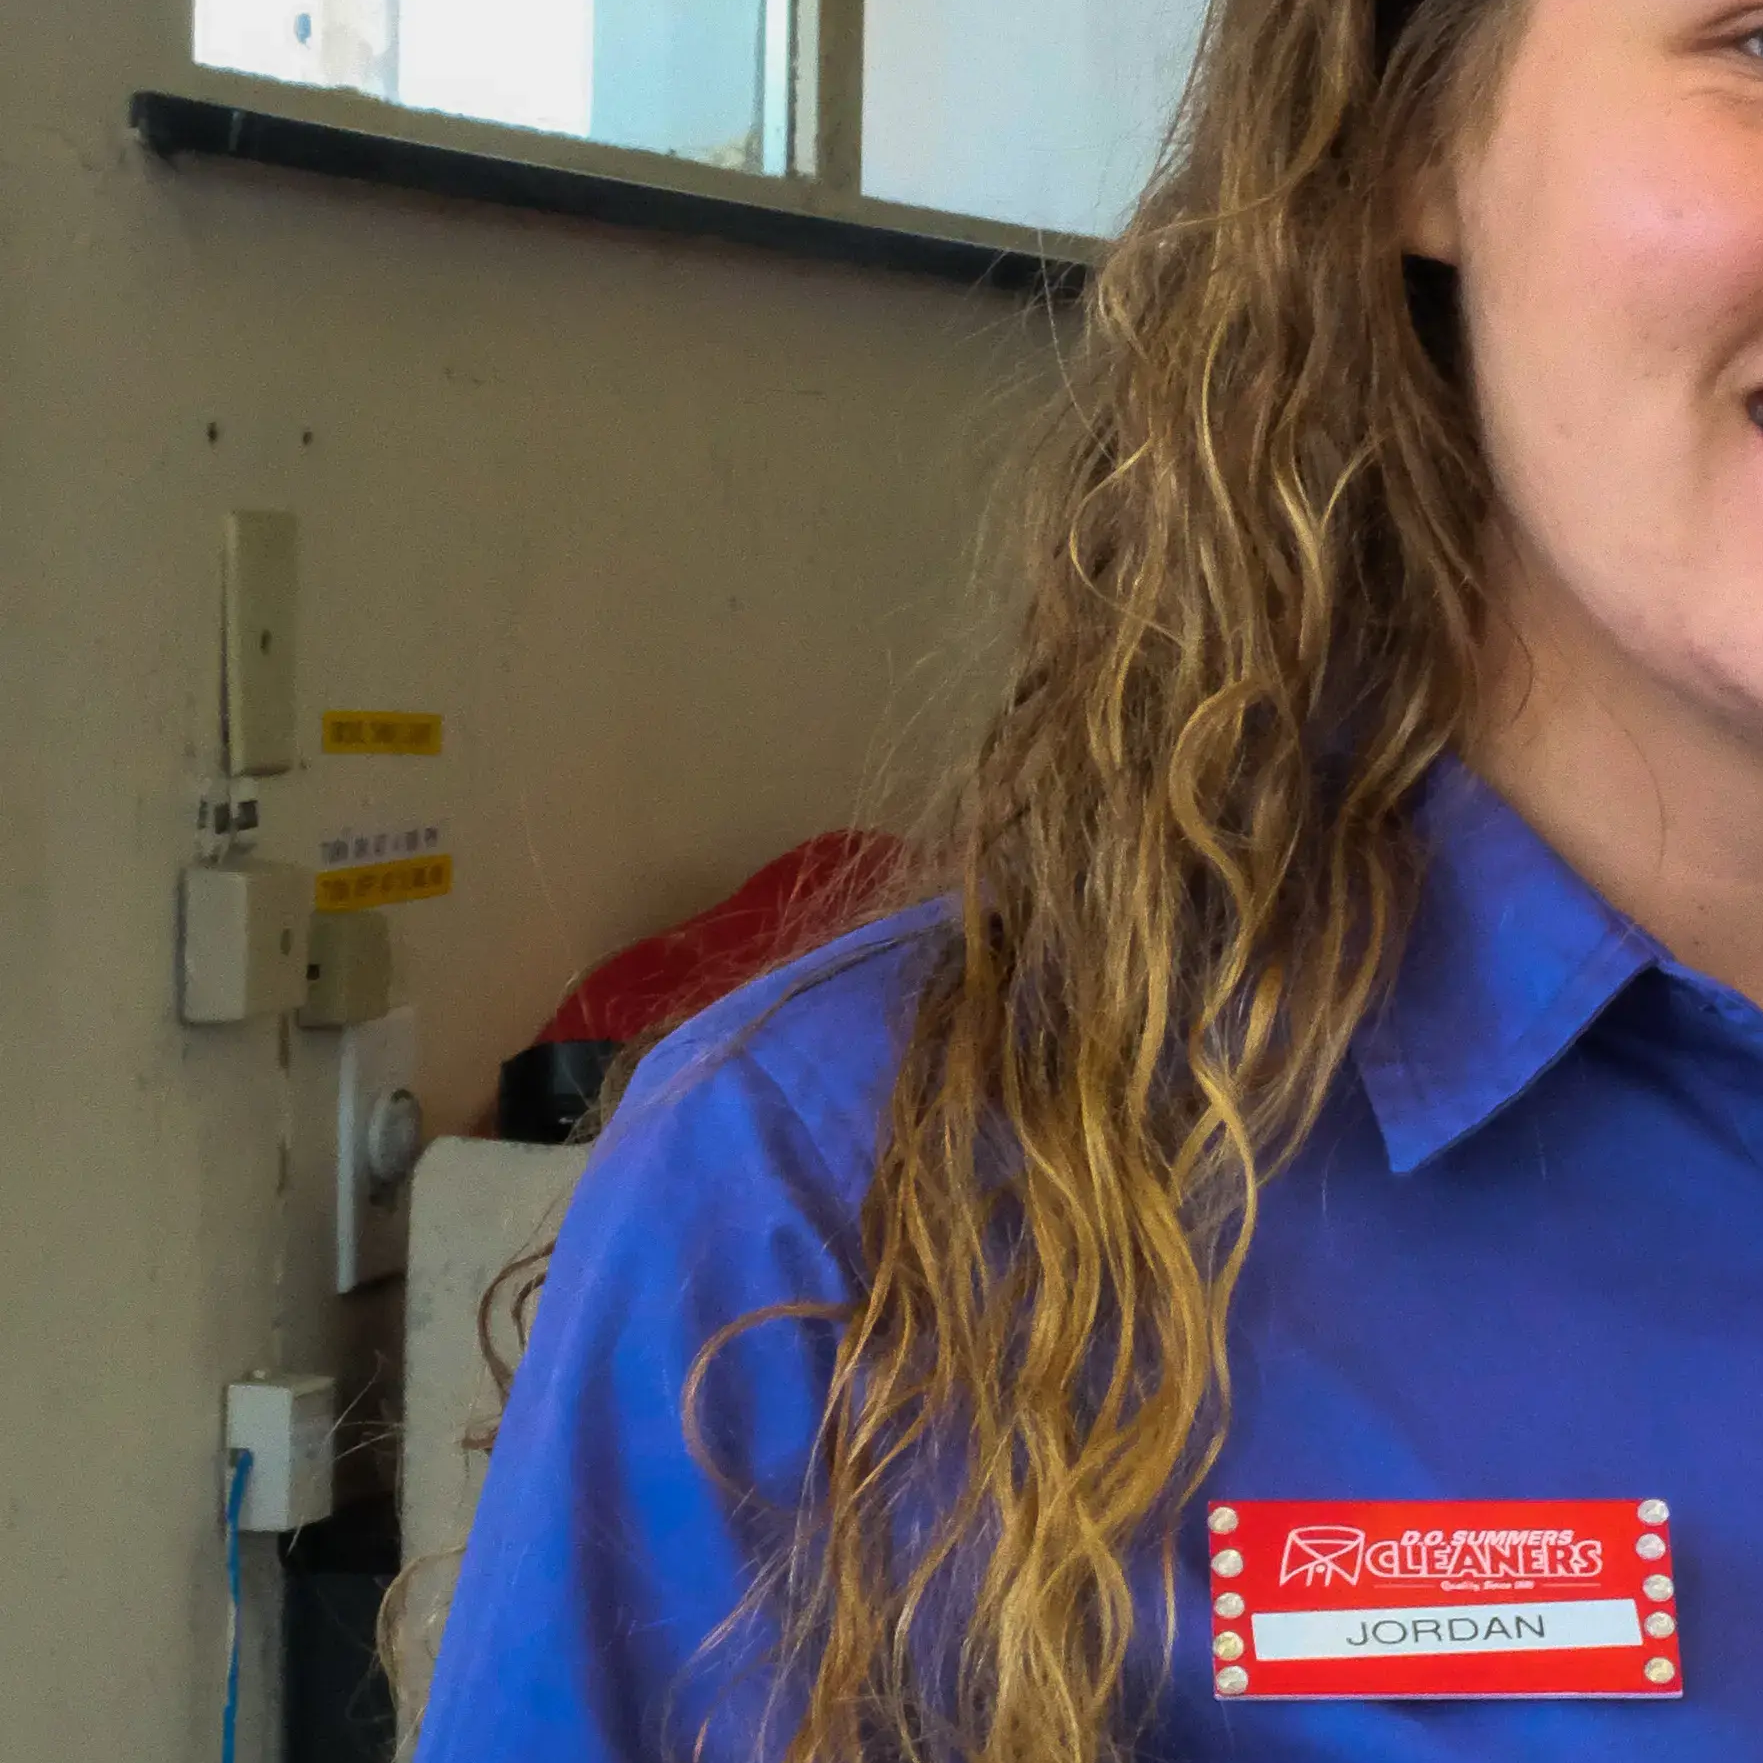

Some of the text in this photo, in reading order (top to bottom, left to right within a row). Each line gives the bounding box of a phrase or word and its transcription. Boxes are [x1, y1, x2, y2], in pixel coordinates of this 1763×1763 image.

[1400, 1528, 1575, 1547] D.O. SUMMERS
[1364, 1539, 1604, 1579] CLEANERS
[1347, 1614, 1546, 1647] JORDAN
